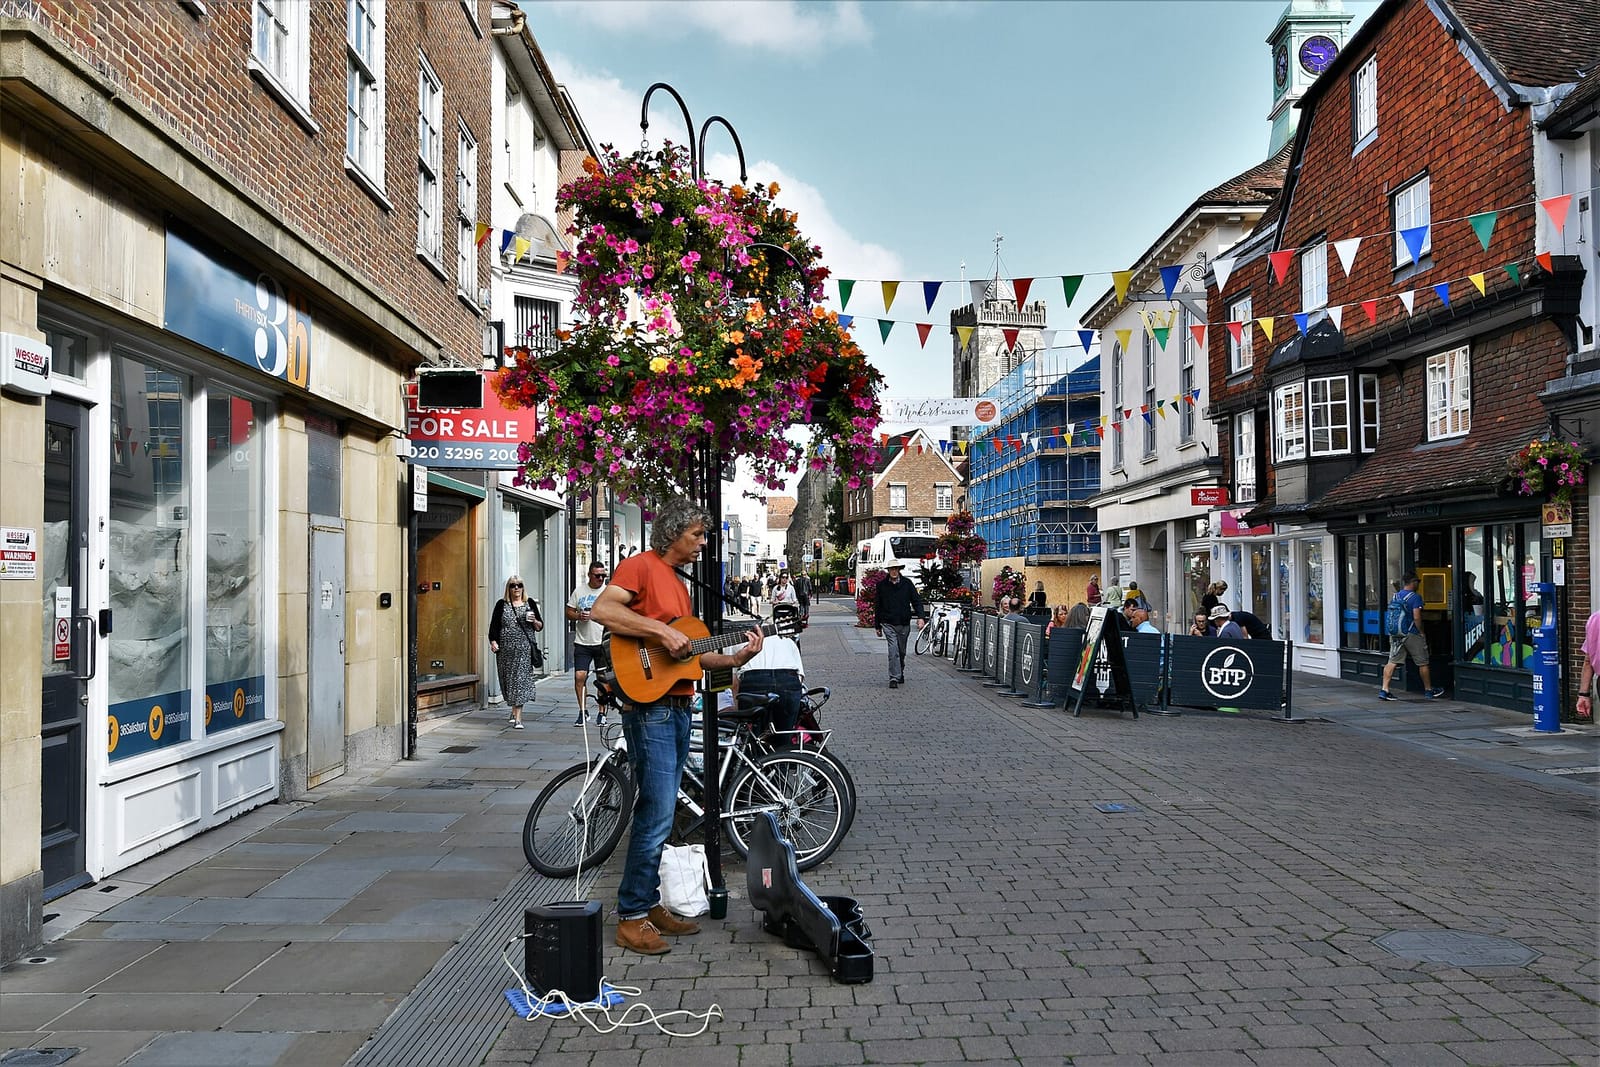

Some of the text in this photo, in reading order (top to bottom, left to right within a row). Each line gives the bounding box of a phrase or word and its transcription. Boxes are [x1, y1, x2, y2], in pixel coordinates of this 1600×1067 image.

[15, 347, 43, 366] wessex
[407, 417, 518, 439] FOR SALE
[410, 446, 439, 459] 020
[444, 447, 483, 460] 3296
[4, 551, 32, 560] WARNING
[1209, 667, 1246, 686] BTP
[119, 721, 147, 737] 36Salisbury
